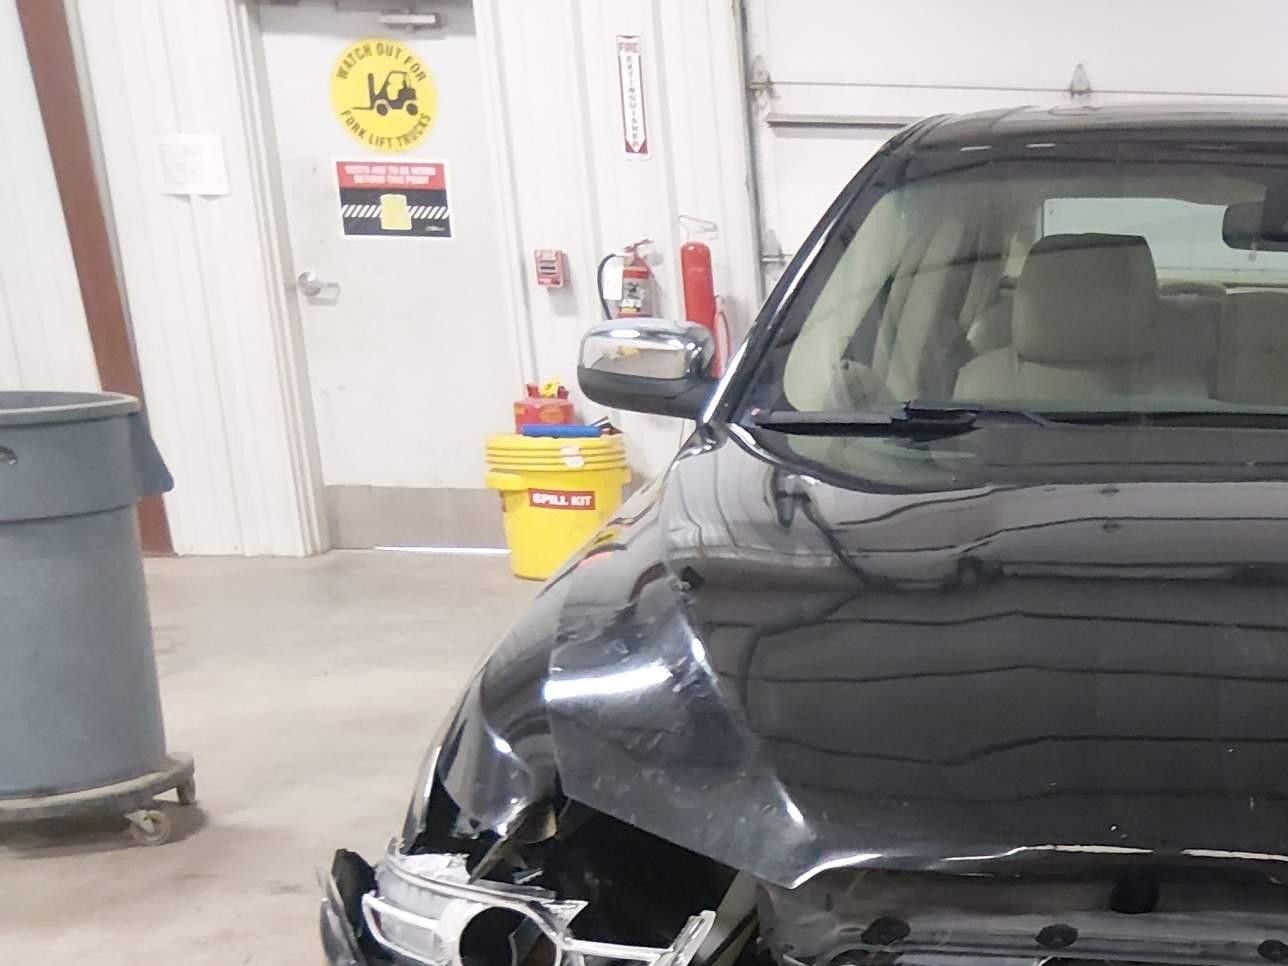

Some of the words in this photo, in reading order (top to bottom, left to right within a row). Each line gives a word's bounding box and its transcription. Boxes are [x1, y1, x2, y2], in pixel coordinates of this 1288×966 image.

[336, 44, 373, 79] WATCH
[376, 42, 403, 60] OUT
[403, 55, 426, 81] FOR
[340, 110, 368, 139] FORK
[369, 133, 393, 148] LIFT
[395, 112, 431, 148] TRUCKS
[533, 493, 569, 506] SPILL
[571, 496, 592, 506] KIT
